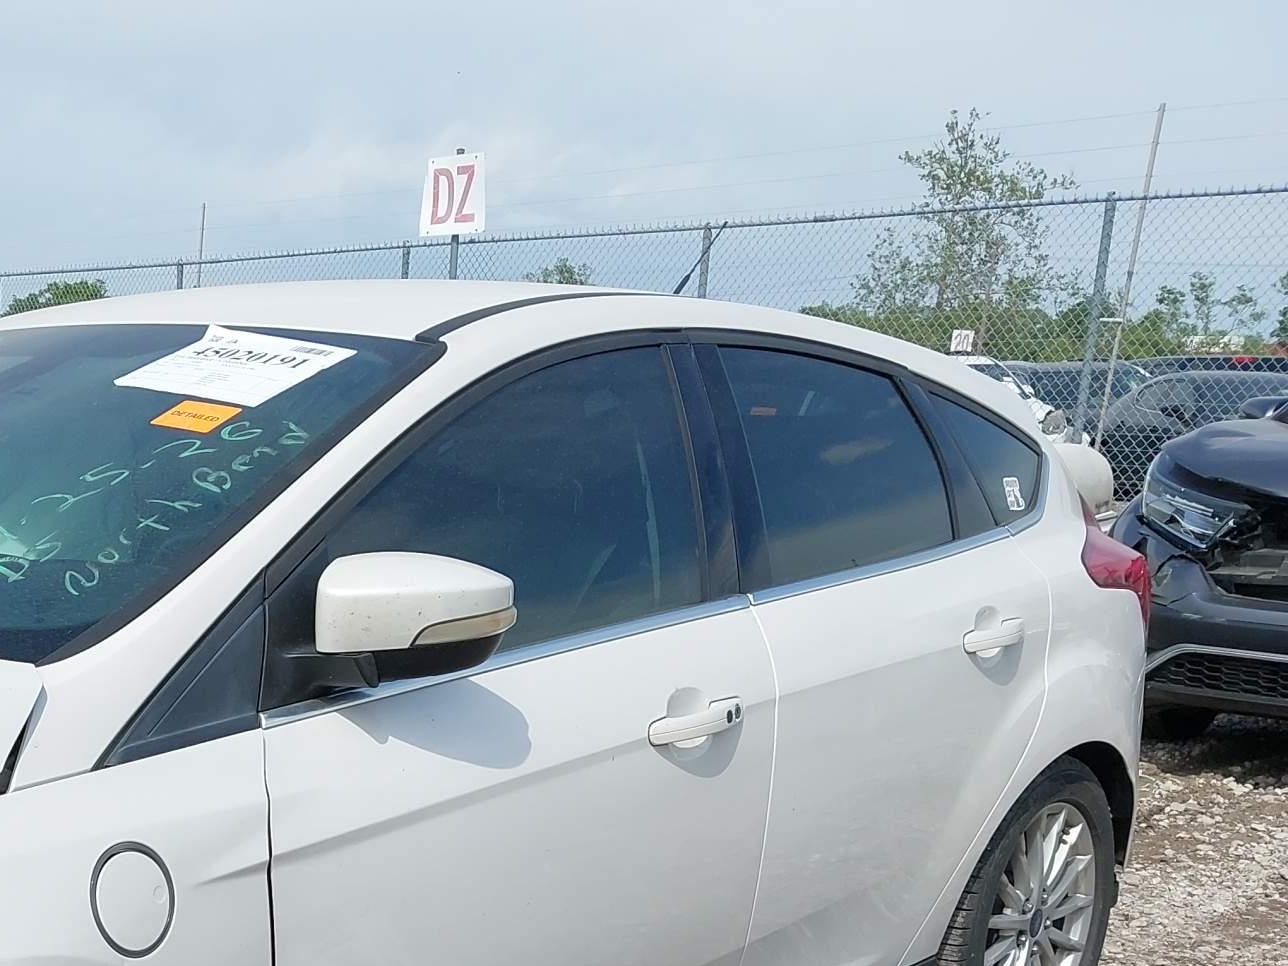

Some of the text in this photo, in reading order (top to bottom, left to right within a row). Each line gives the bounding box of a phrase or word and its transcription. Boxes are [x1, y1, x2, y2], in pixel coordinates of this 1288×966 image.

[431, 164, 475, 225] DZ
[193, 346, 310, 369] 45020191
[171, 409, 221, 423] DETAILED
